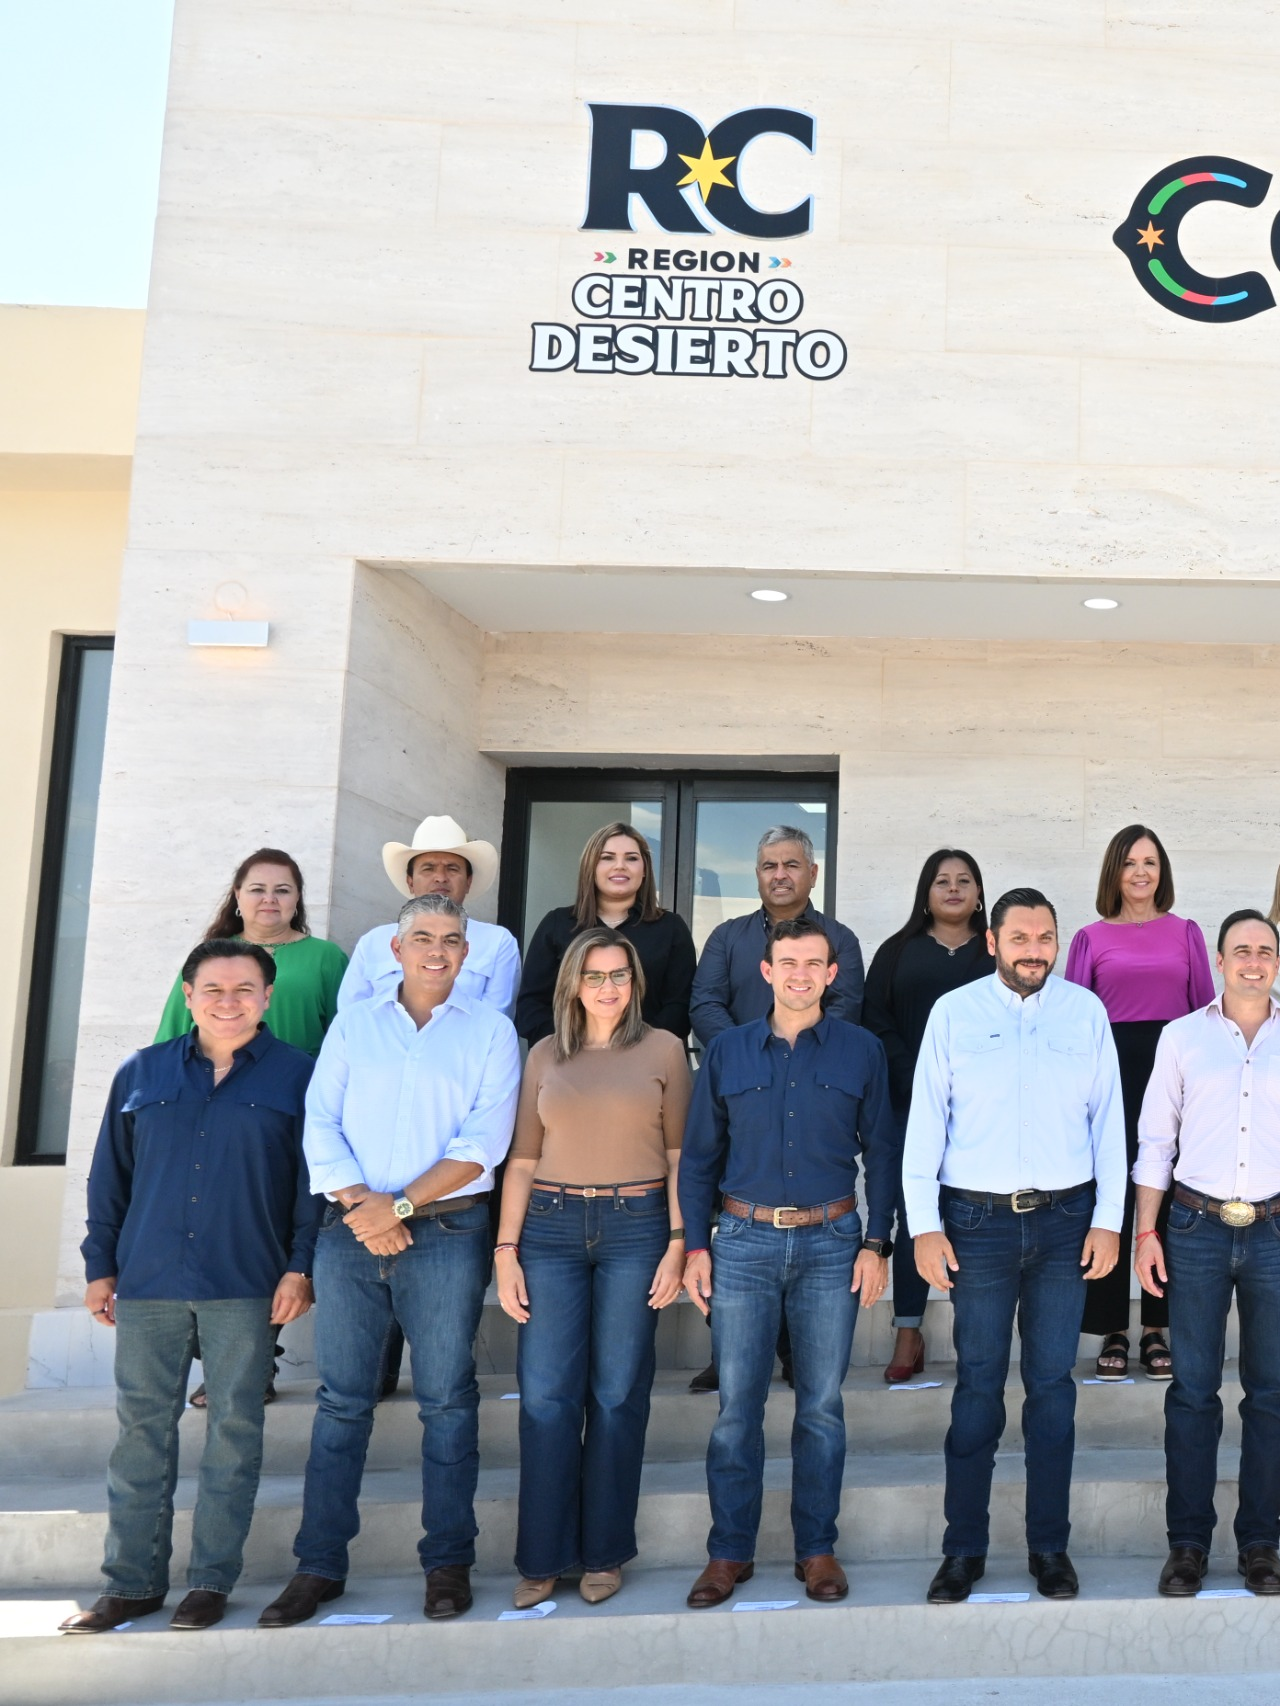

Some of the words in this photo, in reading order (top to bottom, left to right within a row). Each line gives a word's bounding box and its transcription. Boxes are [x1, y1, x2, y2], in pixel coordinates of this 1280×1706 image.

[578, 102, 816, 240] RC
[628, 248, 760, 273] REGION
[571, 272, 804, 325] CENTRO
[528, 321, 848, 381] DESIERTO
